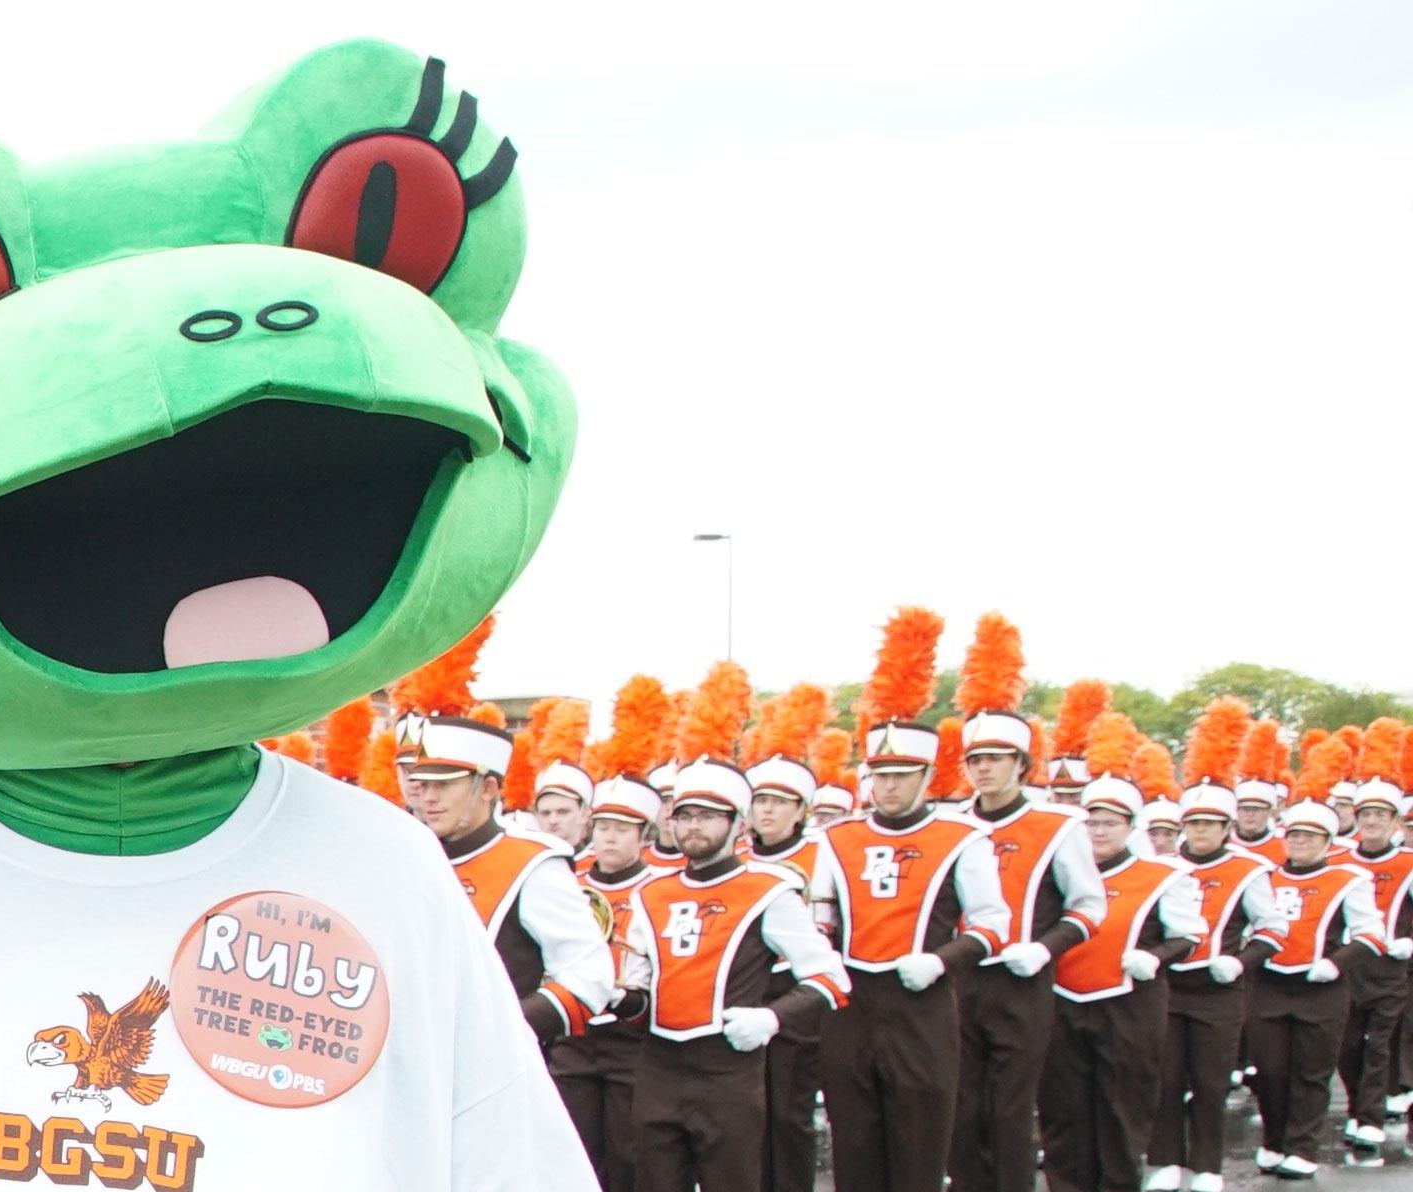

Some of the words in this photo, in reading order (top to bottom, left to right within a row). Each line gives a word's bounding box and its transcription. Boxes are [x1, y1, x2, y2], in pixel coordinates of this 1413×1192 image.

[860, 845, 900, 898] BG
[256, 900, 287, 926] HI,
[297, 909, 332, 934] I'M
[662, 901, 702, 957] BG
[197, 912, 379, 1011] Ruby
[194, 1007, 252, 1037] TREE
[297, 1033, 361, 1065] FROG
[197, 985, 242, 1012] THE
[249, 998, 363, 1041] RED-EYED
[211, 1053, 270, 1081] WBGU
[292, 1073, 326, 1096] PBS
